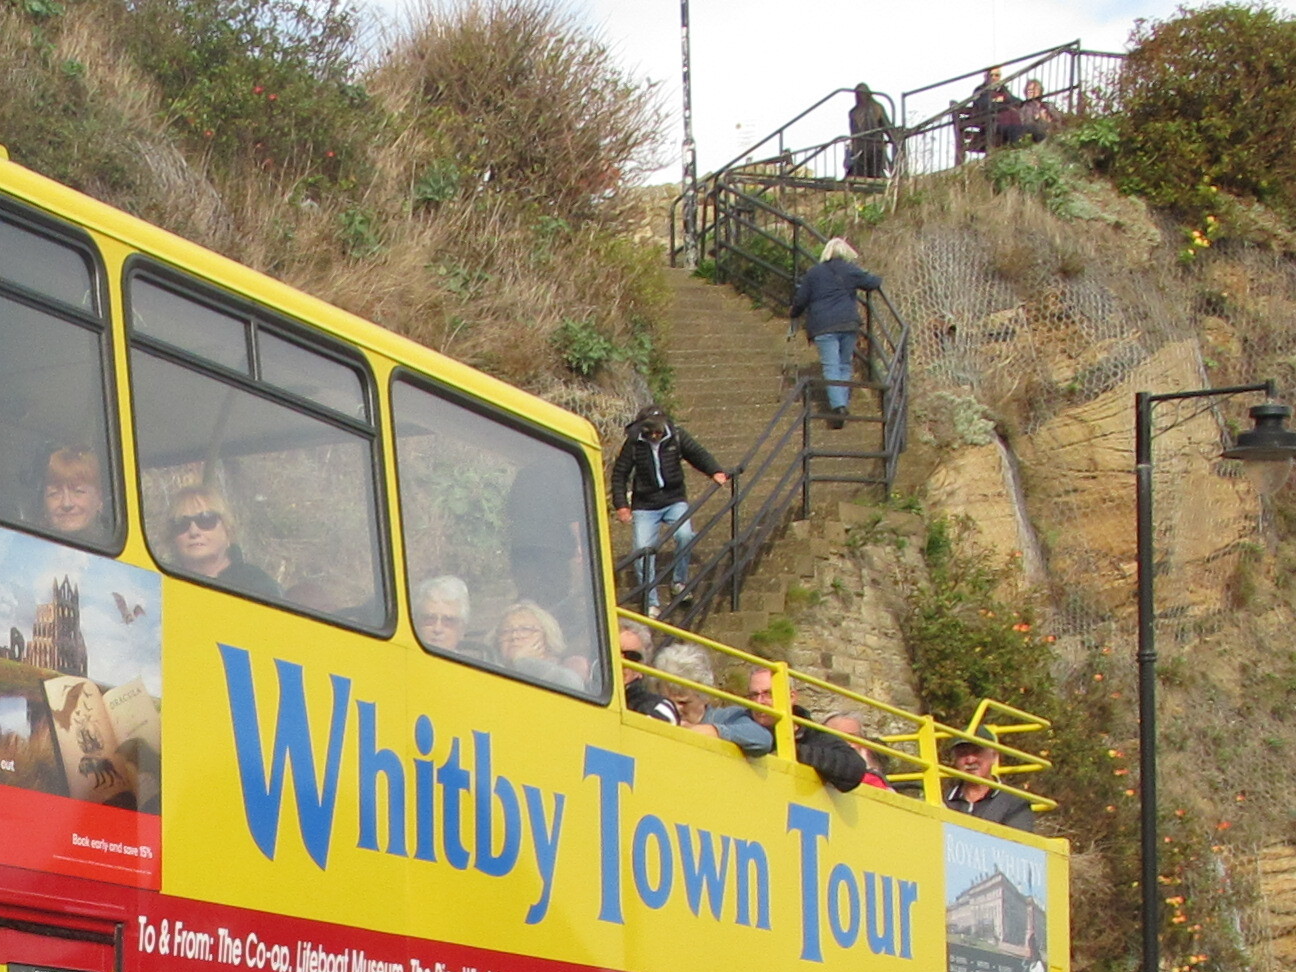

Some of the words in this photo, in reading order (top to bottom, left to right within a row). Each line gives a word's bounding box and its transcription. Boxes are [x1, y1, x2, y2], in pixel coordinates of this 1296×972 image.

[0, 759, 16, 772] out
[216, 641, 566, 926] Whitby
[582, 743, 772, 932] Town
[785, 801, 919, 964] Tour
[72, 833, 90, 847] Book
[90, 839, 109, 853] early
[108, 842, 123, 854] and
[123, 845, 139, 857] save
[138, 915, 155, 953] To
[158, 918, 171, 956] &
[173, 920, 215, 962] From:
[217, 927, 242, 966] The
